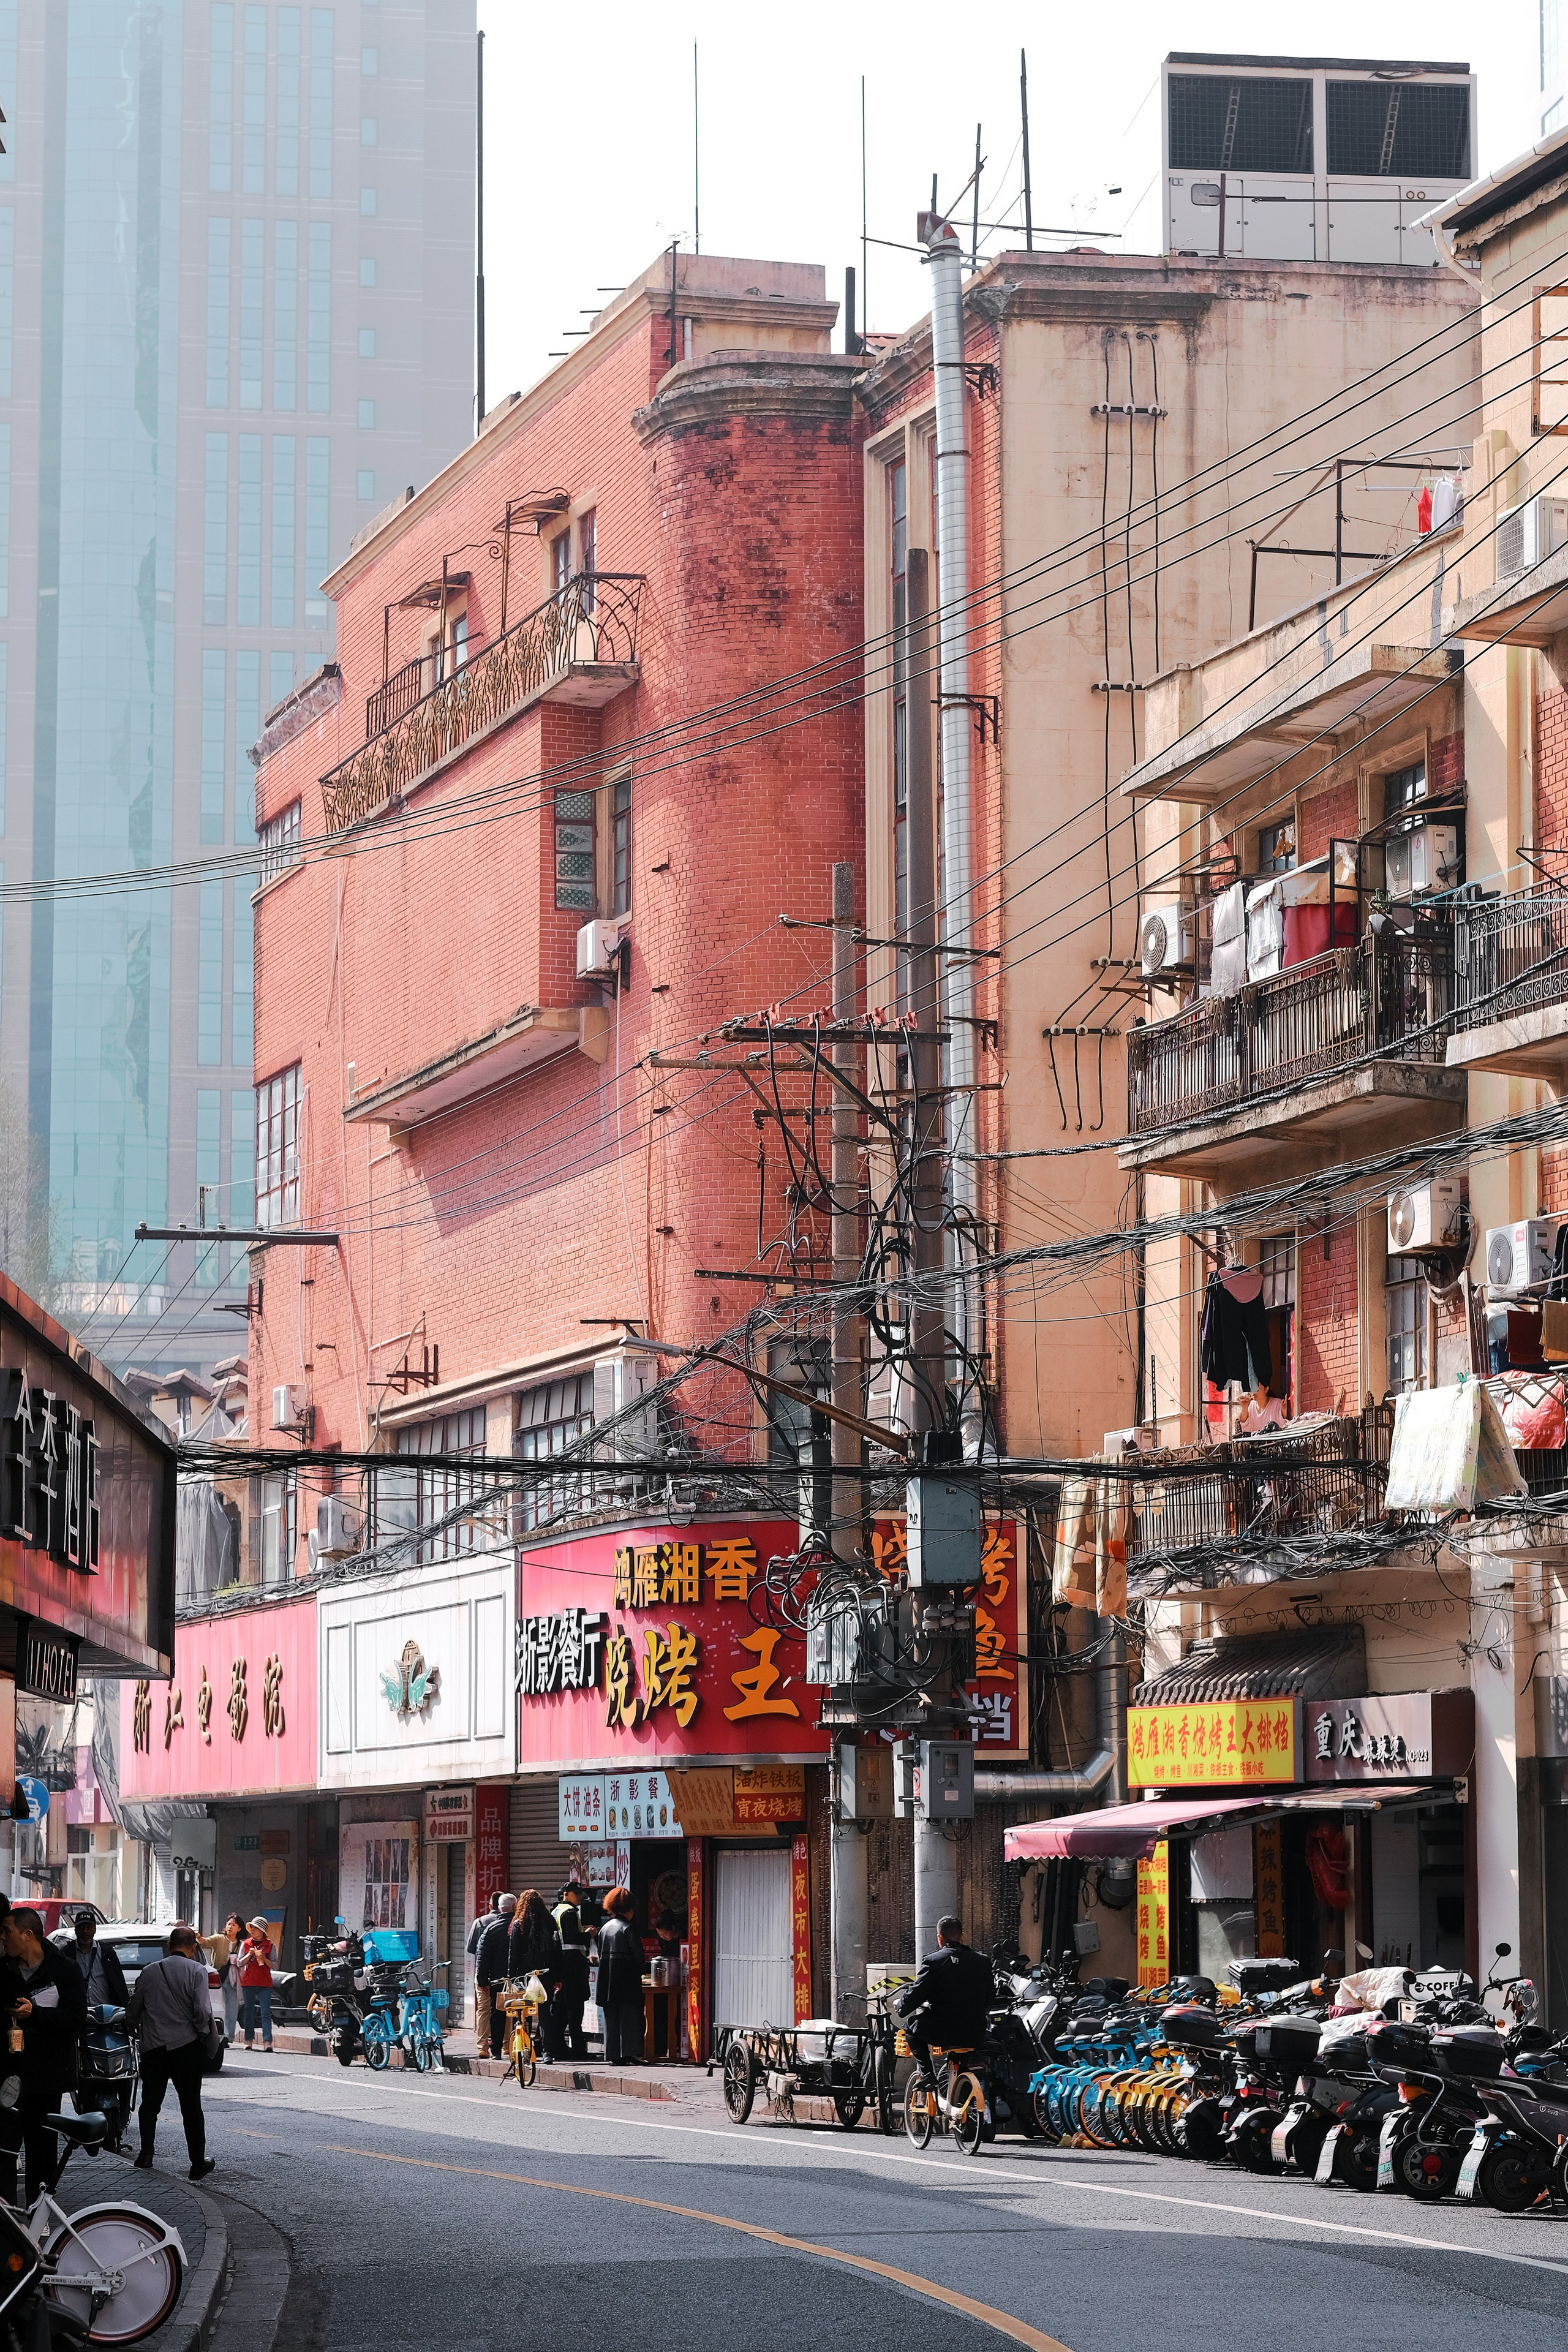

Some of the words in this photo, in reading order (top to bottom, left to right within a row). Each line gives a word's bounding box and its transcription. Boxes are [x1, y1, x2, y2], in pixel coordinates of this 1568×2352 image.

[15, 1368, 102, 1575] 全季酒店
[613, 1536, 758, 1610] 鸿雁湘香
[42, 1643, 74, 1699] HOTEL
[515, 1608, 600, 1695] 浙影餐厅
[606, 1621, 800, 1728] 烧烤王
[1132, 1709, 1289, 1760] 鸿雁湘香烧烤王大排档
[1313, 1709, 1362, 1760] 重庆
[1363, 1734, 1404, 1764] 麻辣烫
[610, 1776, 673, 1802] 浙影餐
[736, 1770, 804, 1790] 油炸铁板
[564, 1785, 601, 1818] 大饼油条
[736, 1796, 803, 1819] 宵夜烧烤
[617, 1847, 629, 1887] 炒
[793, 1841, 808, 1860] 特色
[1139, 1904, 1166, 1930] 烧烤
[794, 1869, 809, 2024] 夜市大排
[1139, 1933, 1166, 1960] 烤鱼
[1140, 1966, 1167, 1989] 川湘菜
